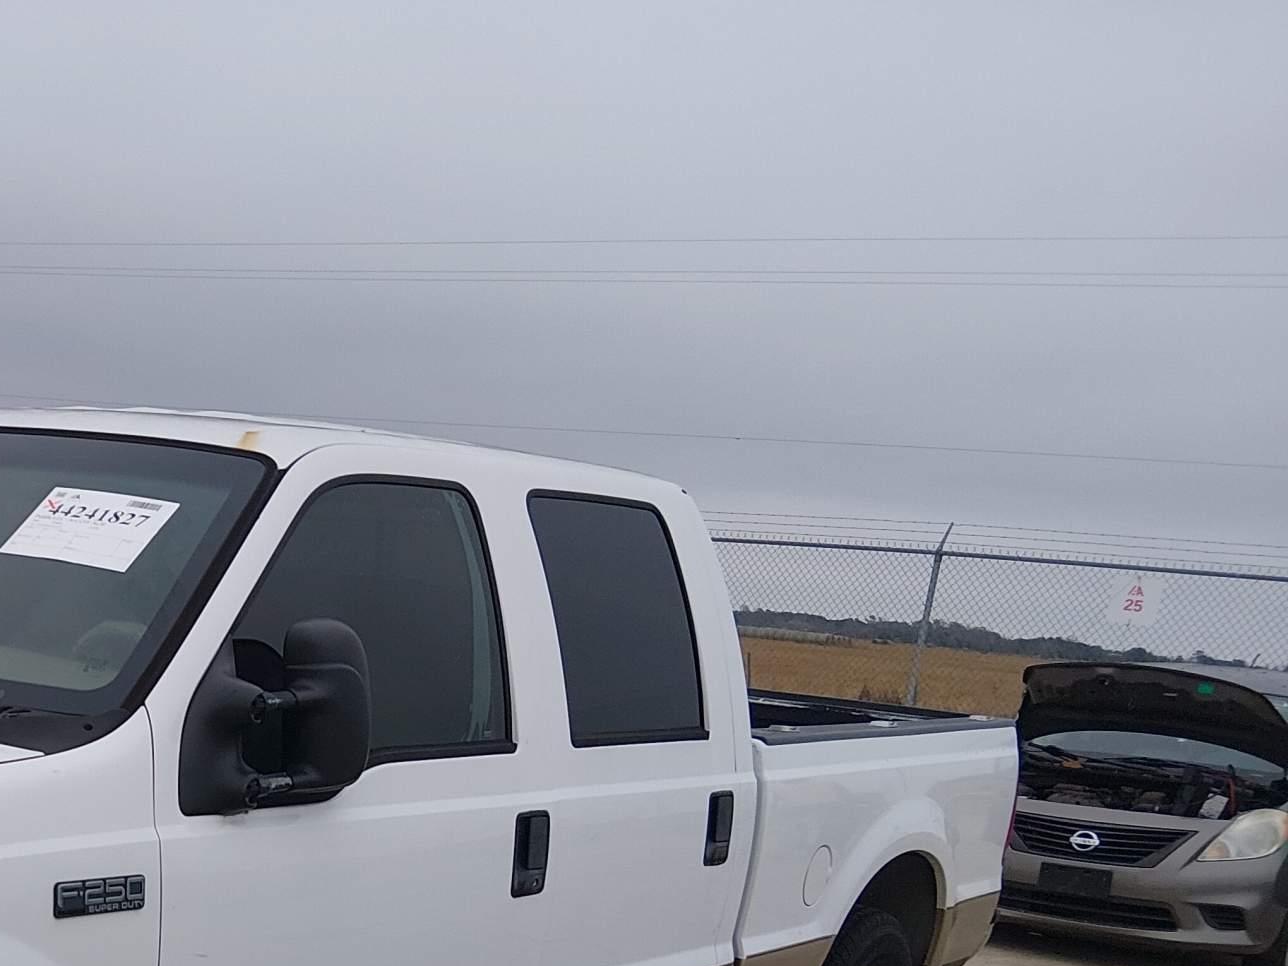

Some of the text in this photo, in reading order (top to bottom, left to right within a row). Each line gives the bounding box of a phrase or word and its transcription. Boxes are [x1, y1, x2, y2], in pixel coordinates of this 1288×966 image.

[48, 503, 152, 527] 44241827
[1123, 599, 1144, 612] 25
[88, 900, 144, 913] SUPER DUTY
